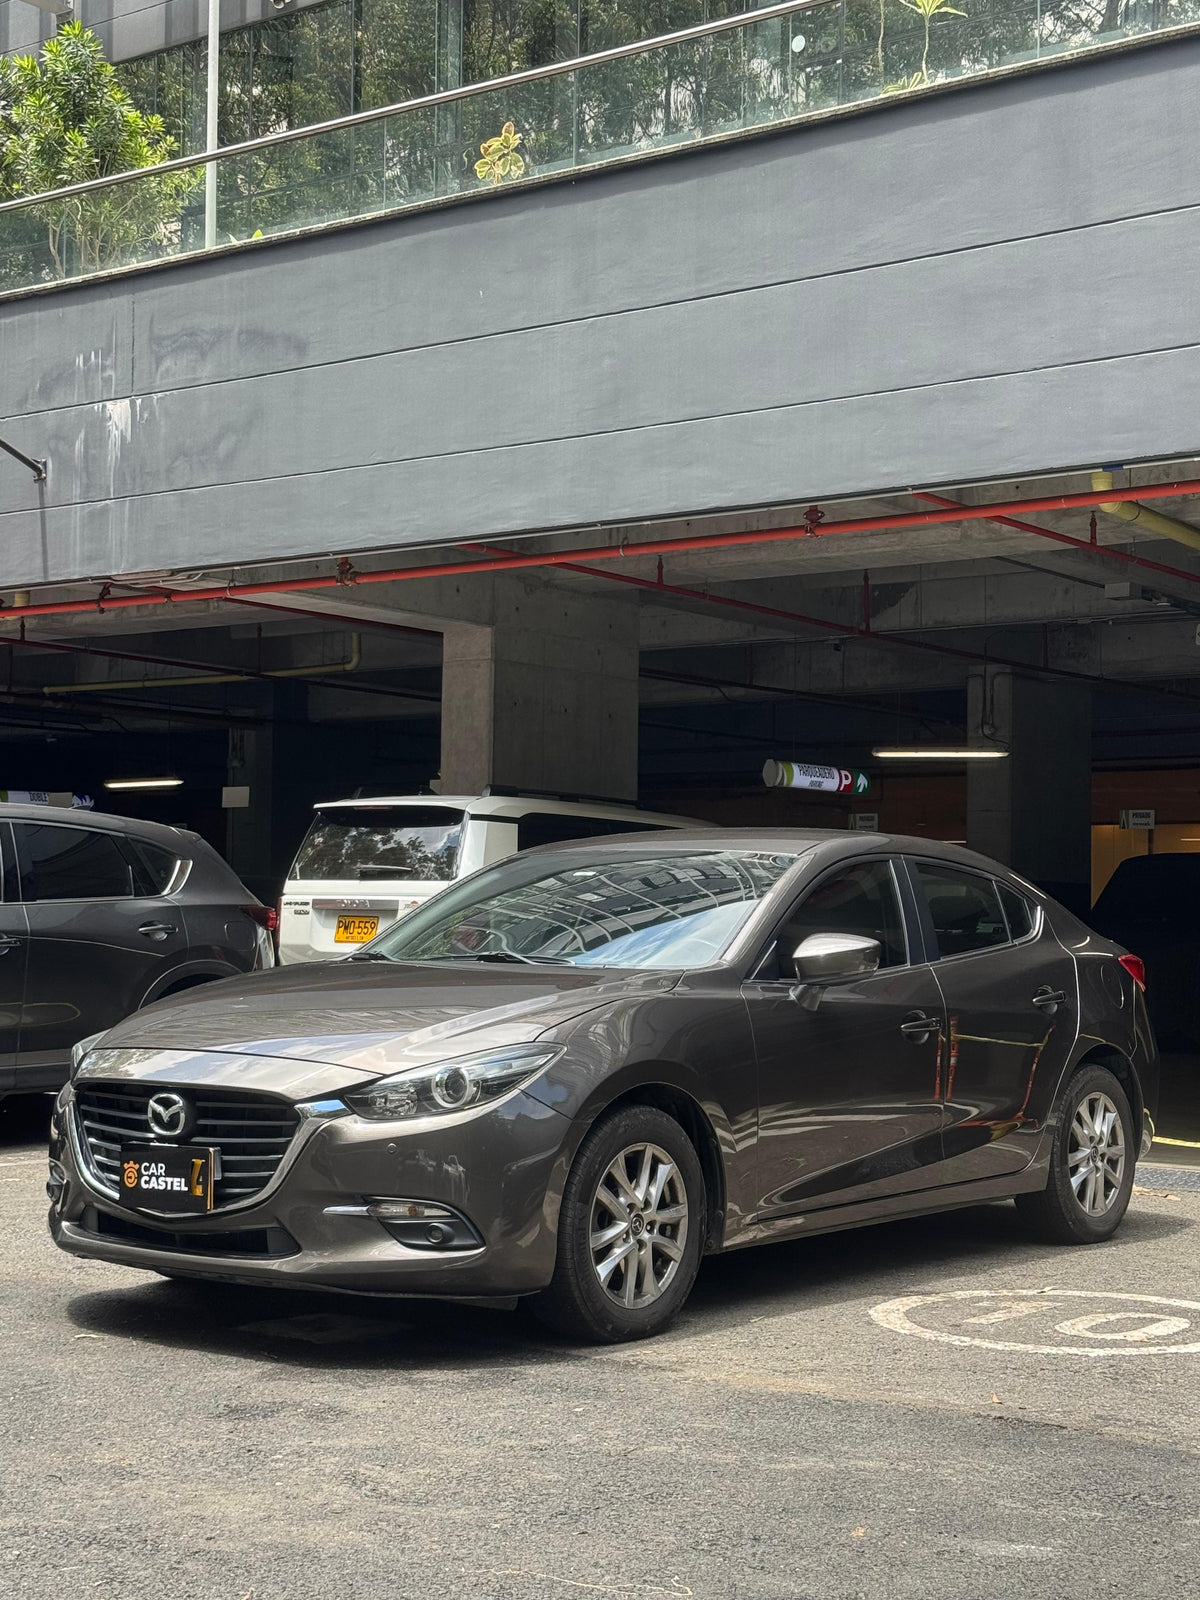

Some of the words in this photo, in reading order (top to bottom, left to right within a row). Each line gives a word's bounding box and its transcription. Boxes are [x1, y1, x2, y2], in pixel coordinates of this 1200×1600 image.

[798, 764, 835, 780] PARQUEADERO
[840, 769, 852, 791] P
[141, 1162, 166, 1176] CAR
[140, 1175, 189, 1192] CASTEL
